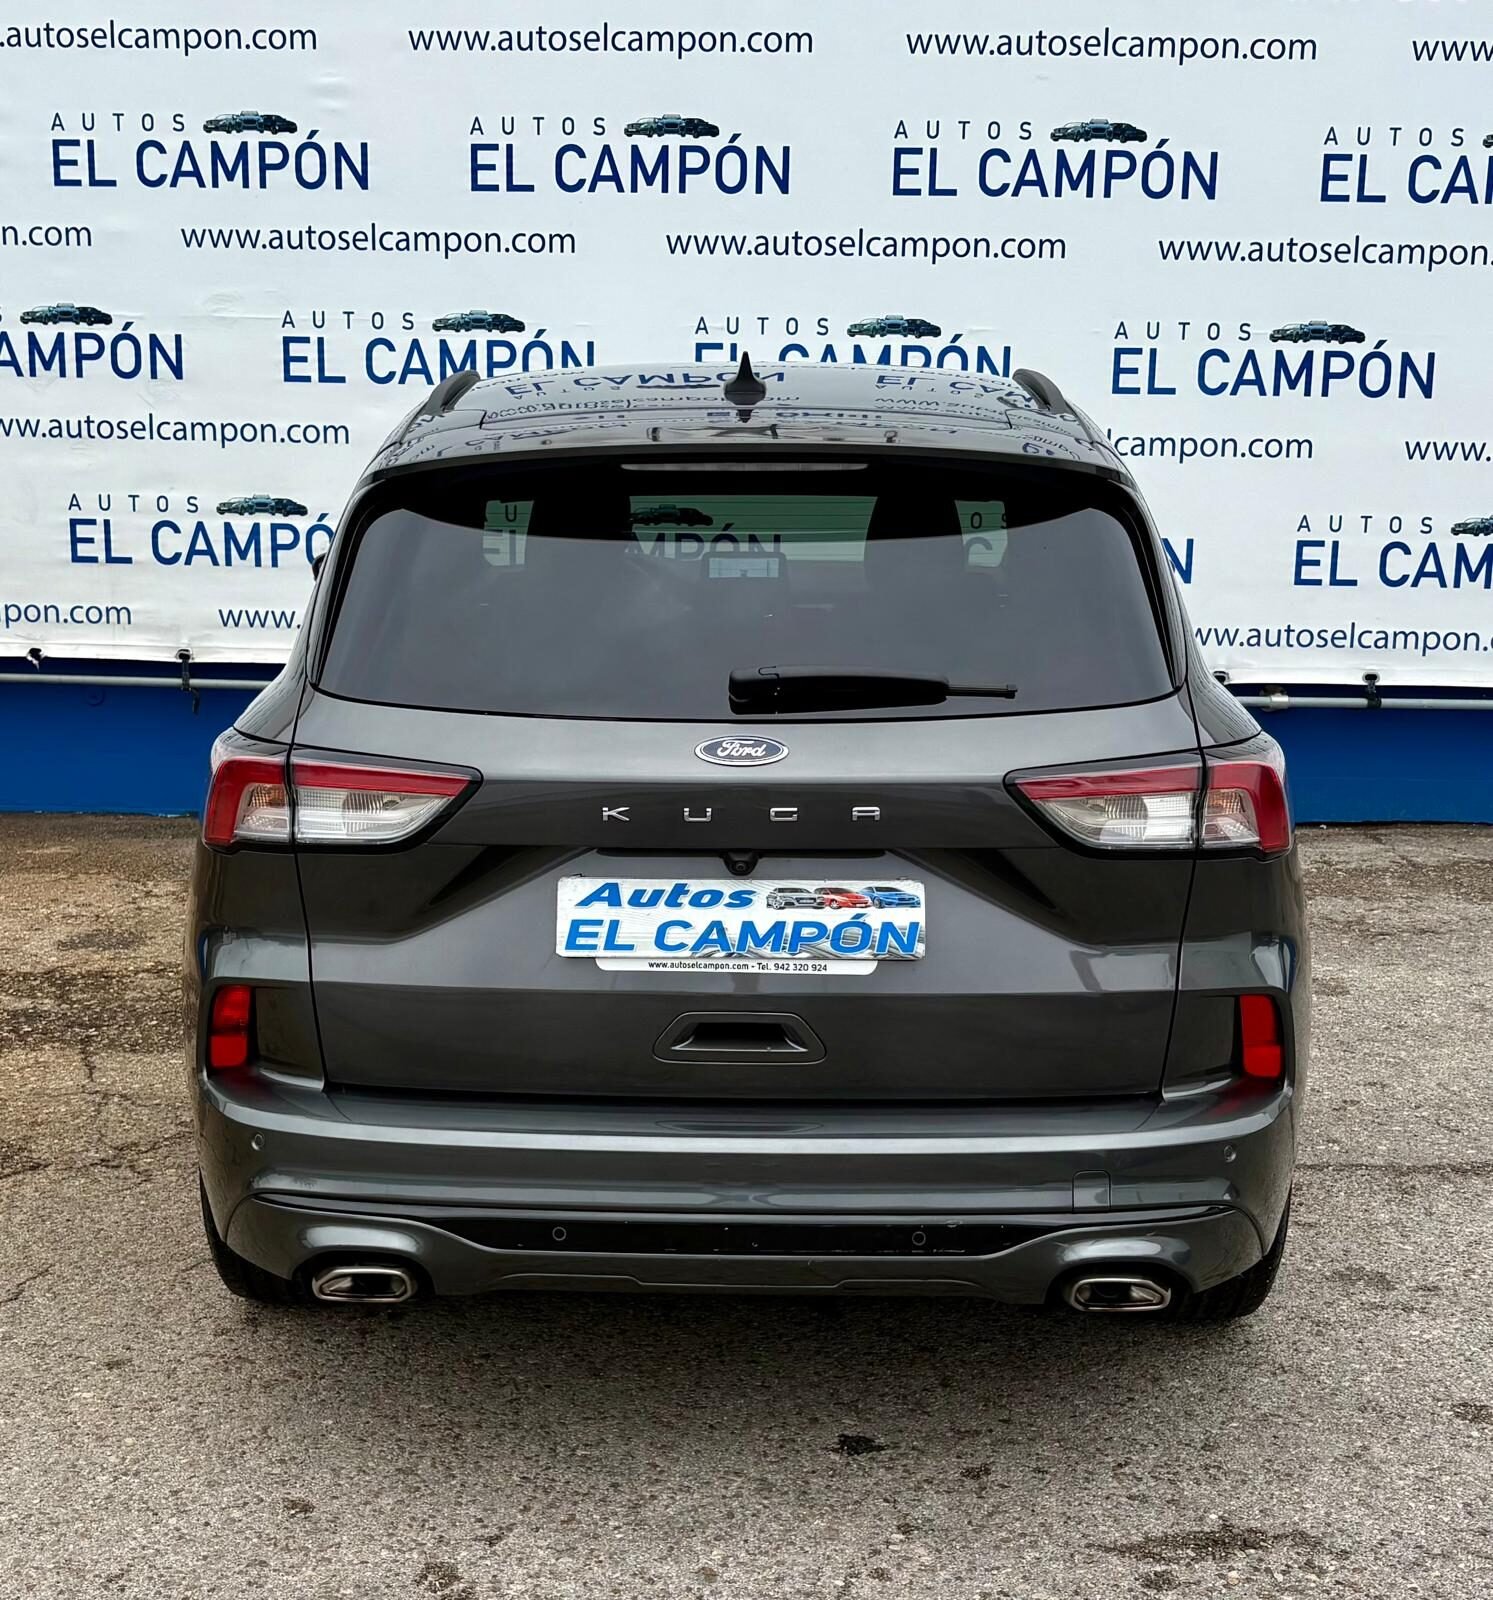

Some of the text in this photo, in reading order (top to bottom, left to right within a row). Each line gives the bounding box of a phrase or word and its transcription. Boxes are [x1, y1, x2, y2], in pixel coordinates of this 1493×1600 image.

[408, 21, 813, 60] www.autoselcampon.com
[906, 26, 1317, 66] www.autoselcampon.com
[50, 112, 185, 132] AUTOS
[469, 116, 606, 136] AUTOS
[893, 119, 1032, 141] AUTOS
[1323, 126, 1464, 147] AUTOS
[51, 129, 369, 191] EL CAMPÓN
[470, 133, 791, 195] EL CAMPÓN
[892, 139, 1219, 201] EL CAMPÓN
[1320, 153, 1493, 205] EL CA
[180, 222, 576, 260] www.autoselcampon.com
[665, 227, 1066, 265] www.autoselcampon.com
[281, 310, 414, 331] AUTOS
[694, 316, 829, 336] AUTOS
[1114, 321, 1251, 342] AUTOS
[282, 335, 347, 384] EL
[1111, 339, 1436, 400] EL CAMPÓN
[68, 493, 199, 514] AUTOS
[69, 517, 133, 565] EL
[1296, 514, 1433, 535] AUTOS
[1293, 539, 1358, 587] EL
[716, 738, 767, 760] Ford
[601, 805, 882, 823] KUGA
[574, 881, 759, 910] Autos
[564, 912, 922, 955] EL CAMPÓN
[648, 960, 749, 971] www.autoselcampon.com
[757, 962, 771, 971] Tel.
[774, 962, 790, 971] 942
[792, 963, 809, 972] 320
[812, 963, 828, 972] 924
